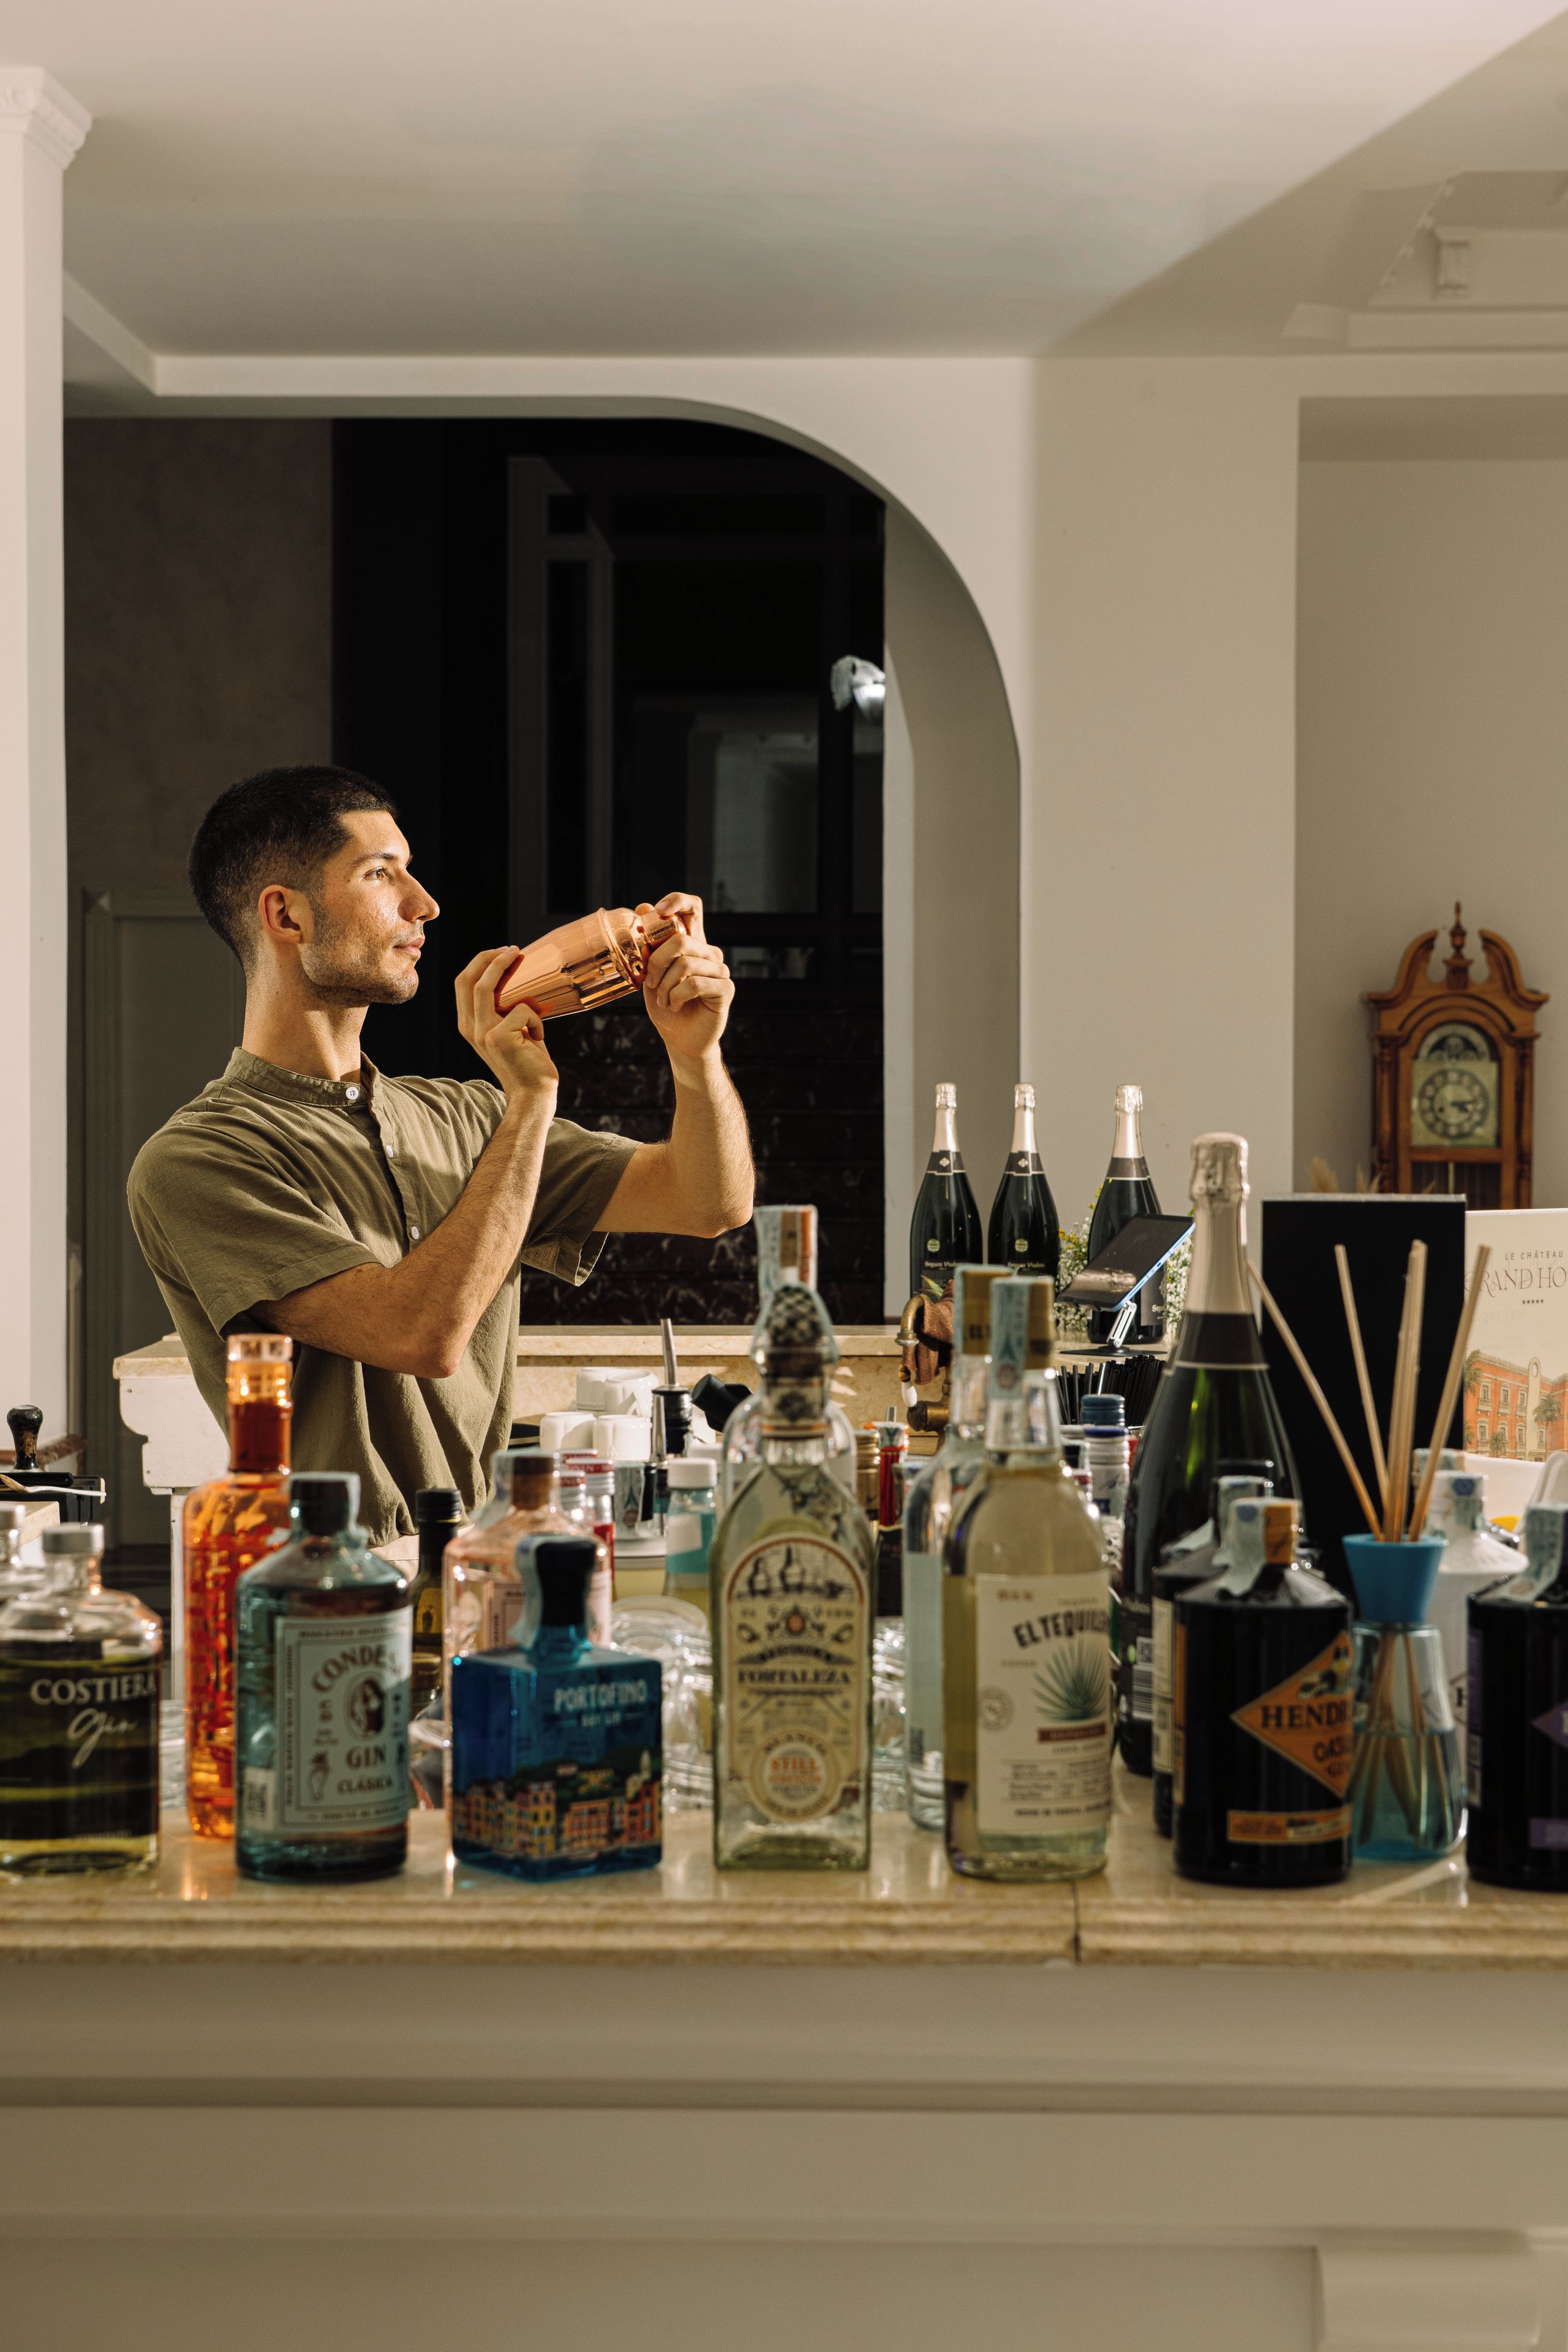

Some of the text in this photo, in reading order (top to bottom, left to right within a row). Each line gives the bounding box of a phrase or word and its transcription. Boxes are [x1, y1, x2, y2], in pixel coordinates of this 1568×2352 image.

[1520, 1250, 1563, 1260] CHÂTEAU
[1538, 1267, 1568, 1289] HO
[1012, 1620, 1040, 1648] EL
[554, 1679, 647, 1713] PORTOFINO
[345, 1745, 386, 1769] GIN
